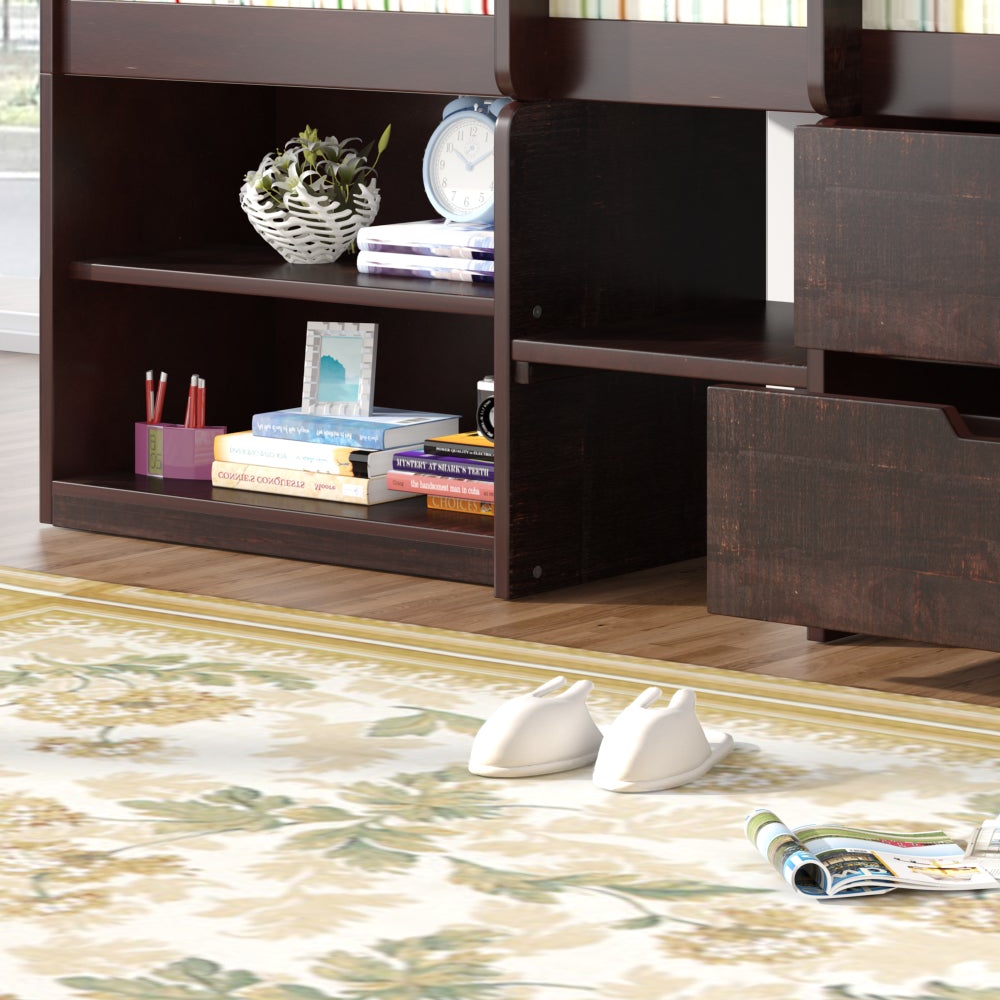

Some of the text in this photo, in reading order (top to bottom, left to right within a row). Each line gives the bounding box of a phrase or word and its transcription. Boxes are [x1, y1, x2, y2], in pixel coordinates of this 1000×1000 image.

[457, 130, 464, 141] 11
[469, 126, 478, 137] 12
[484, 132, 489, 143] 1
[446, 142, 454, 153] 10
[439, 160, 446, 170] 9
[442, 177, 448, 188] 8
[451, 190, 457, 201] 7
[478, 192, 485, 203] 5
[463, 196, 470, 207] 6
[396, 458, 489, 477] MYSTERY AT SHARK'S TEETH
[410, 479, 419, 488] the
[449, 485, 461, 493] man
[432, 496, 478, 512] CHOICES
